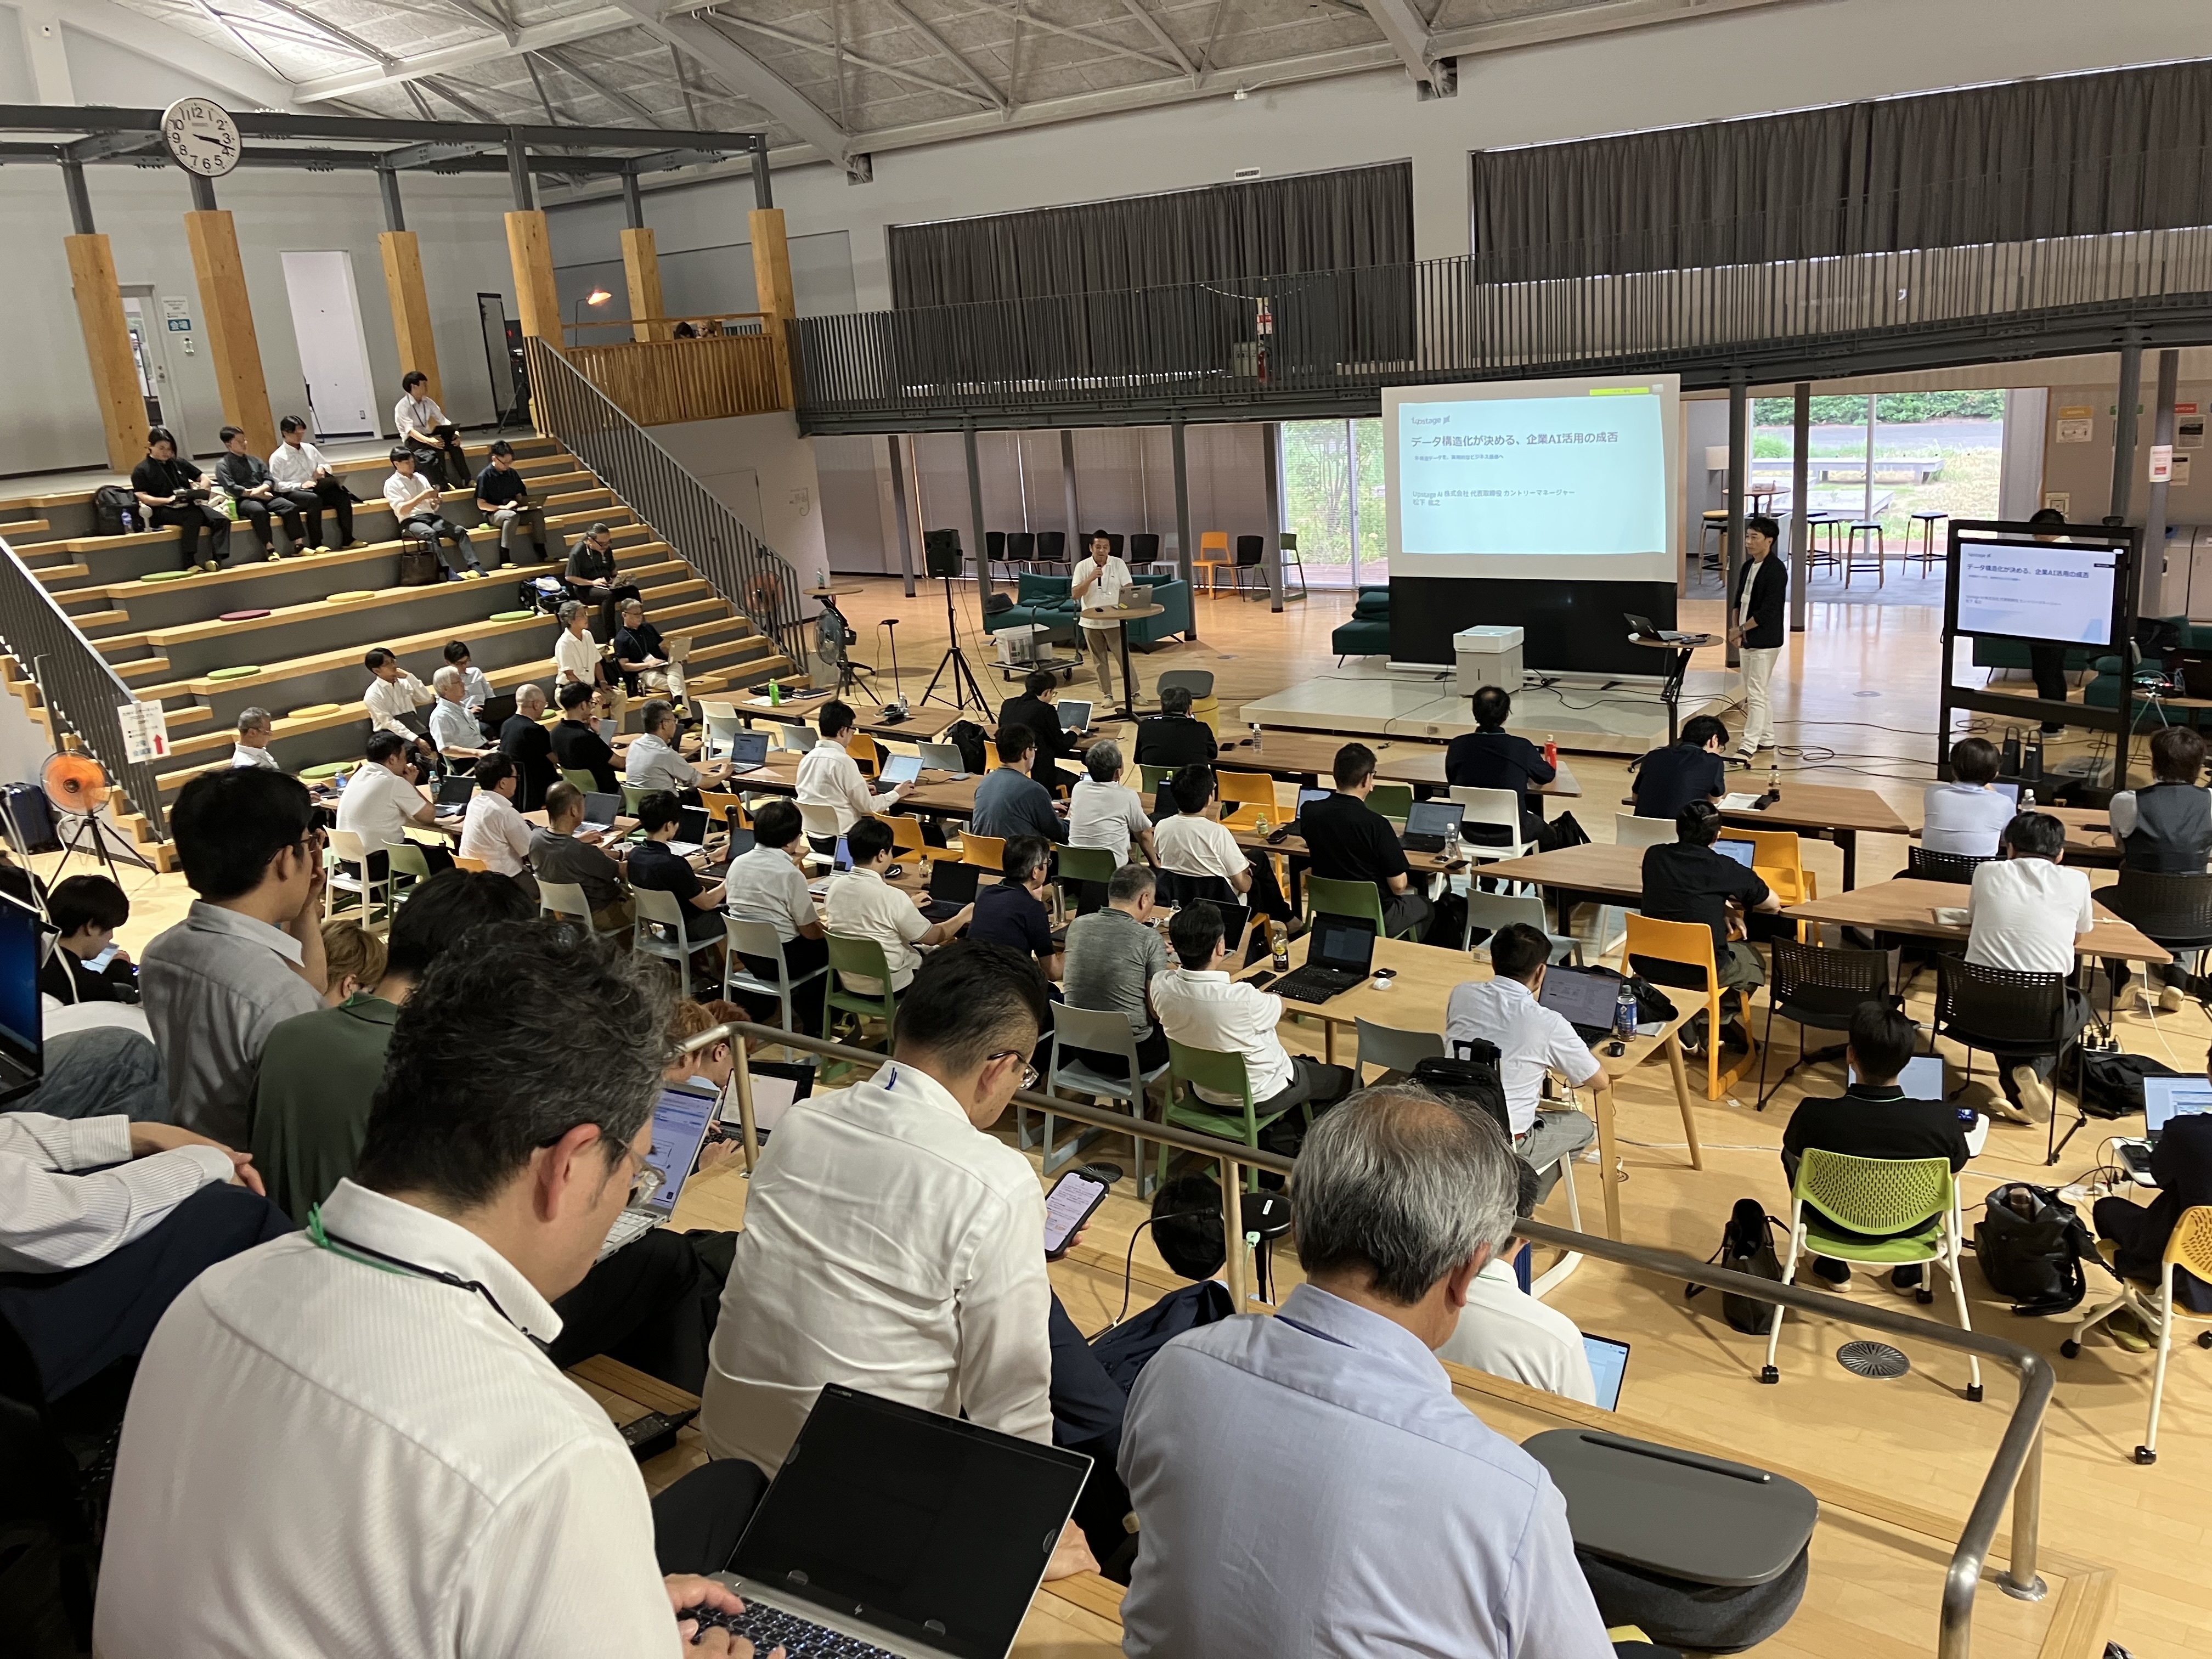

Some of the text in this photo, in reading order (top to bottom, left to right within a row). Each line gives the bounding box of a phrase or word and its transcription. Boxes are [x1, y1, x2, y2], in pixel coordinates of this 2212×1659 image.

[179, 107, 191, 120] 11
[191, 107, 204, 118] 12
[208, 110, 213, 121] 1
[169, 119, 184, 131] 10
[216, 119, 225, 131] 2
[172, 132, 180, 143] 9
[222, 133, 231, 144] 3
[179, 144, 188, 155] 8
[222, 147, 230, 156] 4
[190, 155, 198, 166] 7
[202, 158, 211, 169] 6
[215, 155, 223, 166] 5
